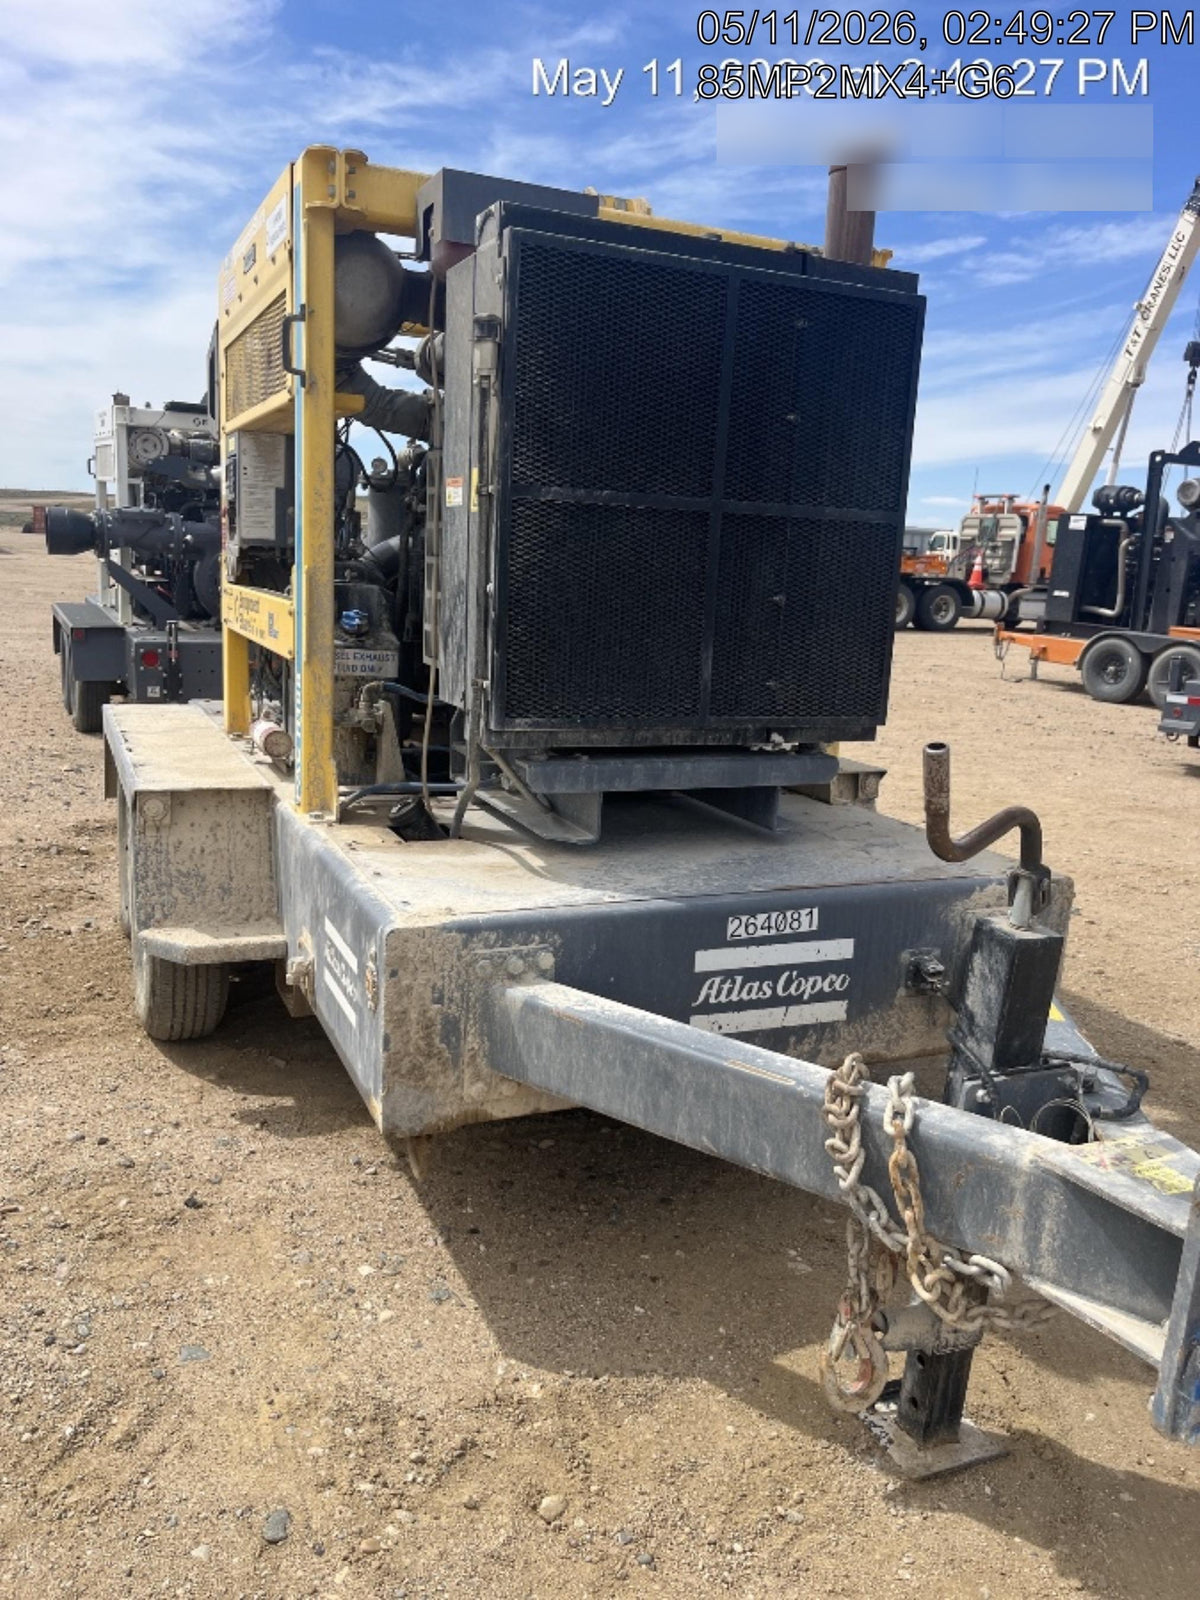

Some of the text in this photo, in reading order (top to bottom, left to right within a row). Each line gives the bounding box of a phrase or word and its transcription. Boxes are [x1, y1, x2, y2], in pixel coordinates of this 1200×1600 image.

[1140, 264, 1171, 321] CRANES
[1168, 231, 1185, 260] LLC
[729, 908, 815, 938] 264081
[692, 970, 850, 1007] Atlas Copco
